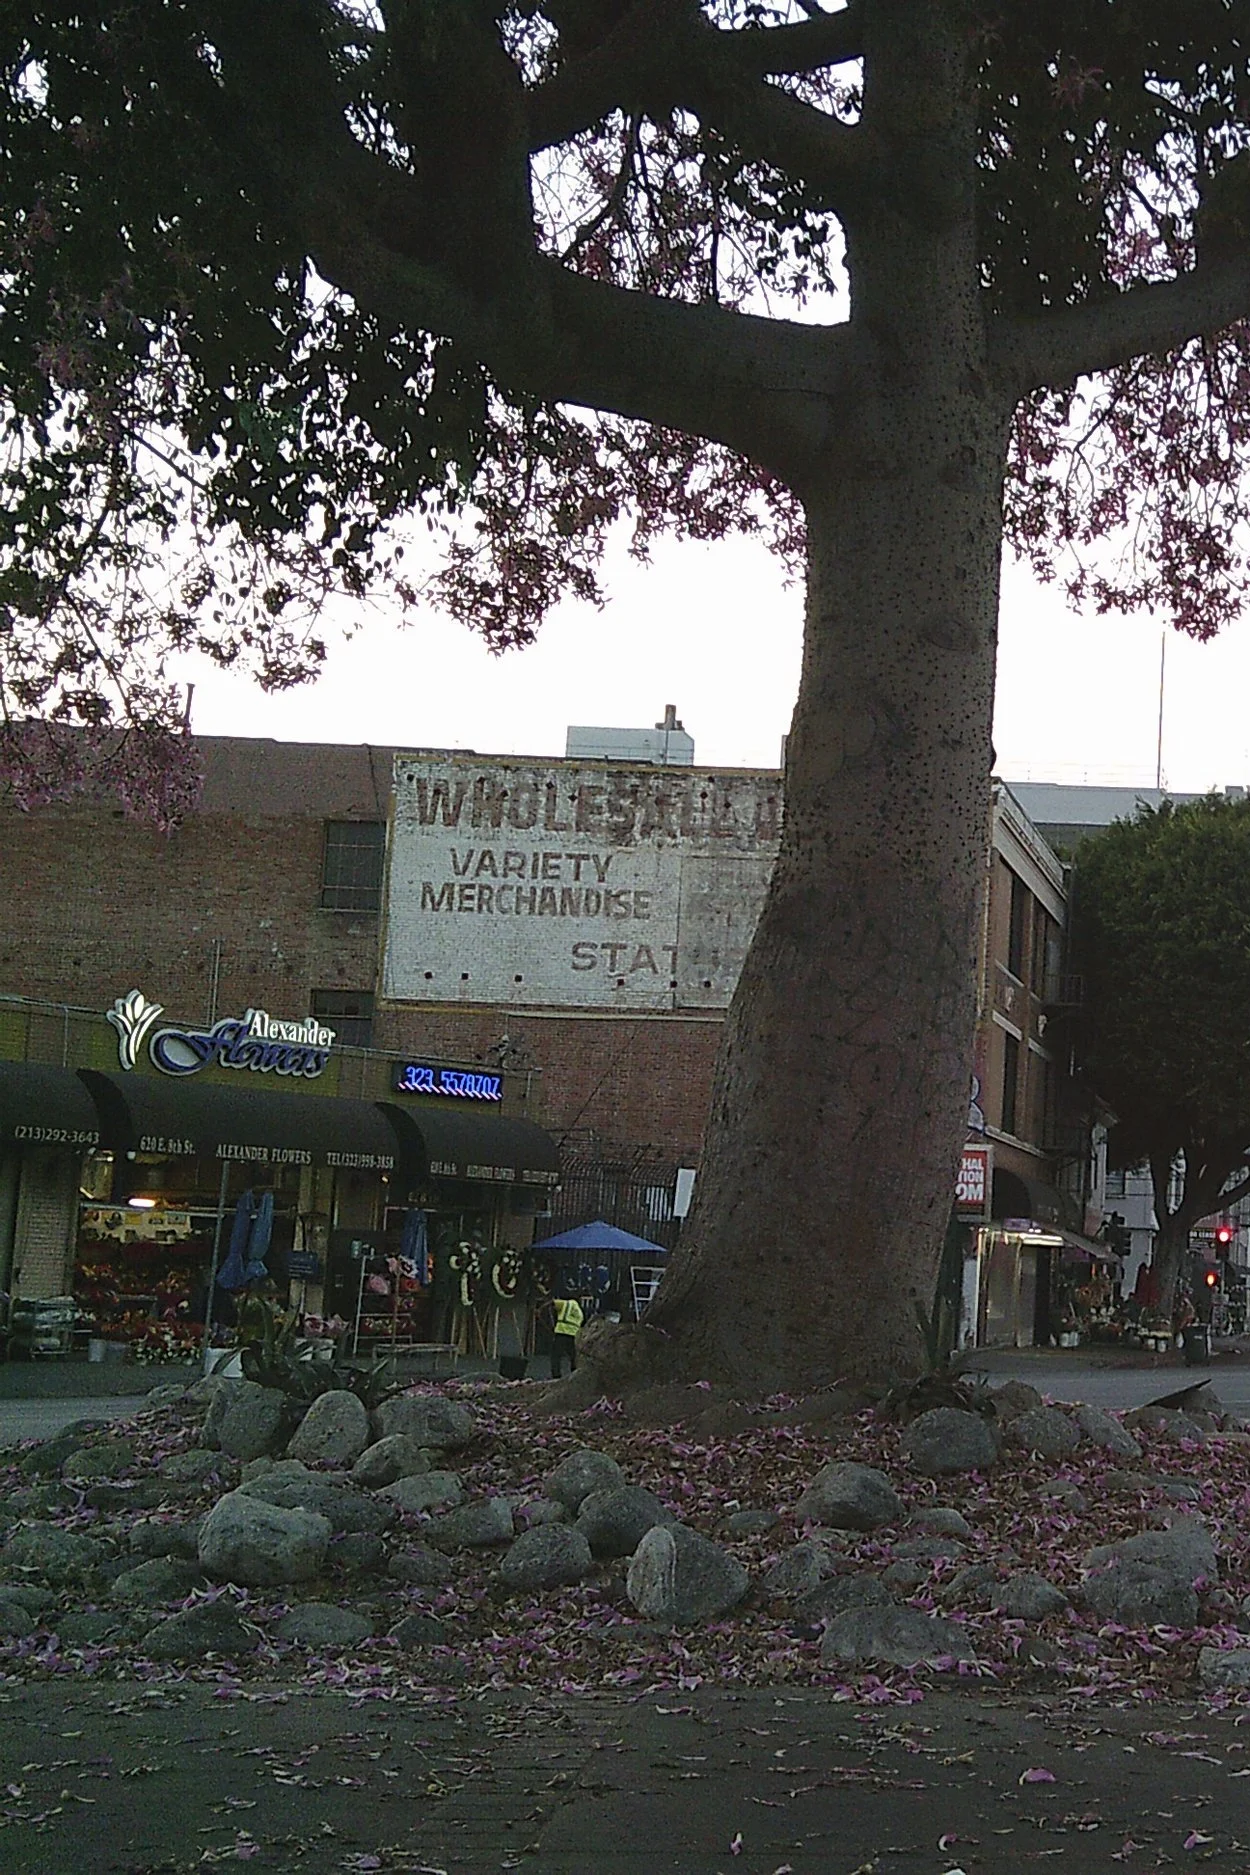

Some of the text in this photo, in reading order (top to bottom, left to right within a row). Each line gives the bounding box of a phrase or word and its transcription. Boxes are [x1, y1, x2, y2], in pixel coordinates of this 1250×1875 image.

[450, 847, 613, 883] VARIETY
[420, 880, 651, 921] MERCHANDISE
[249, 1011, 337, 1047] Alexander
[151, 1019, 330, 1077] Flowers
[405, 1065, 435, 1089] 323
[14, 1125, 101, 1145] (213)292-3643
[215, 1143, 269, 1162] ALEXANDER
[271, 1148, 312, 1165] FLOWERS
